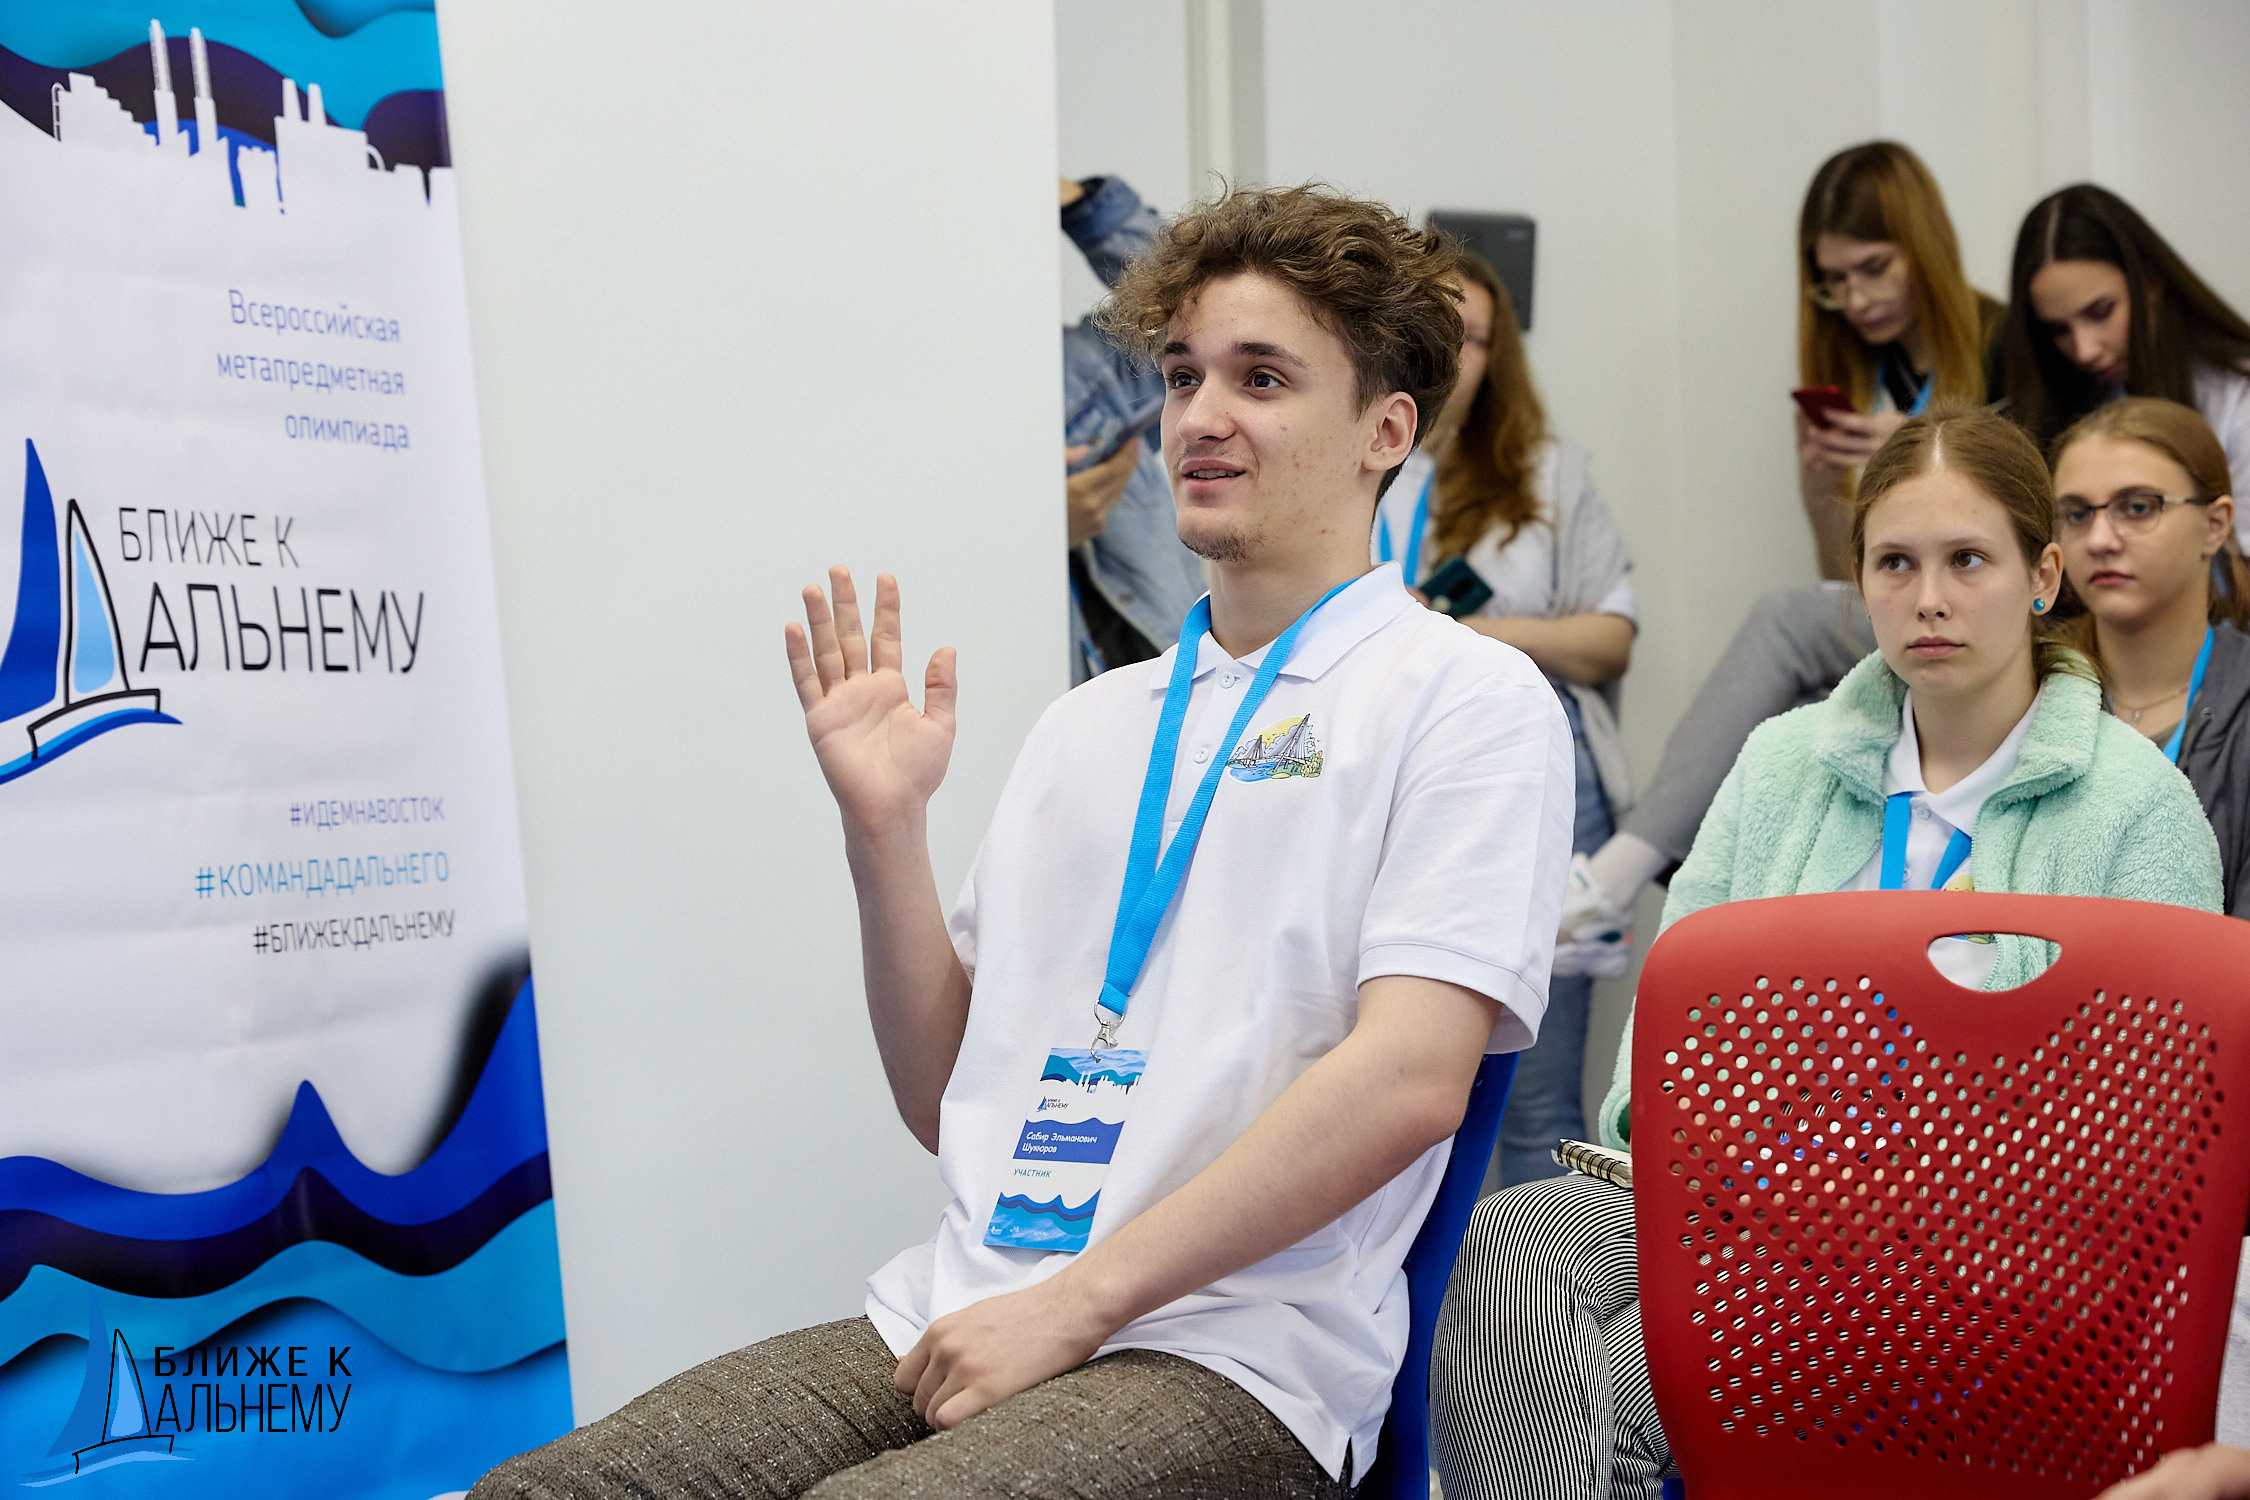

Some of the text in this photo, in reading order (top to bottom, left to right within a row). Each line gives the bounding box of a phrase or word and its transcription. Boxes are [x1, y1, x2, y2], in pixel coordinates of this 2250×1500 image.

[228, 289, 401, 343] Всероссийская
[217, 352, 405, 395] метапредметная
[285, 413, 410, 453] олимпиада
[118, 507, 300, 568] БЛИЖЕ К
[290, 797, 445, 831] #ИДЕМНАВОСТОК
[195, 851, 449, 899] #КОМАНДАДАЛЬНЕГО
[253, 909, 455, 954] #БЛИЖЕКДАЛЬНЕМУ
[1022, 1142, 1058, 1155] Шукюров
[1026, 1131, 1098, 1144] Сабир Эльманович
[1013, 1168, 1051, 1178] УЧАСТНИК
